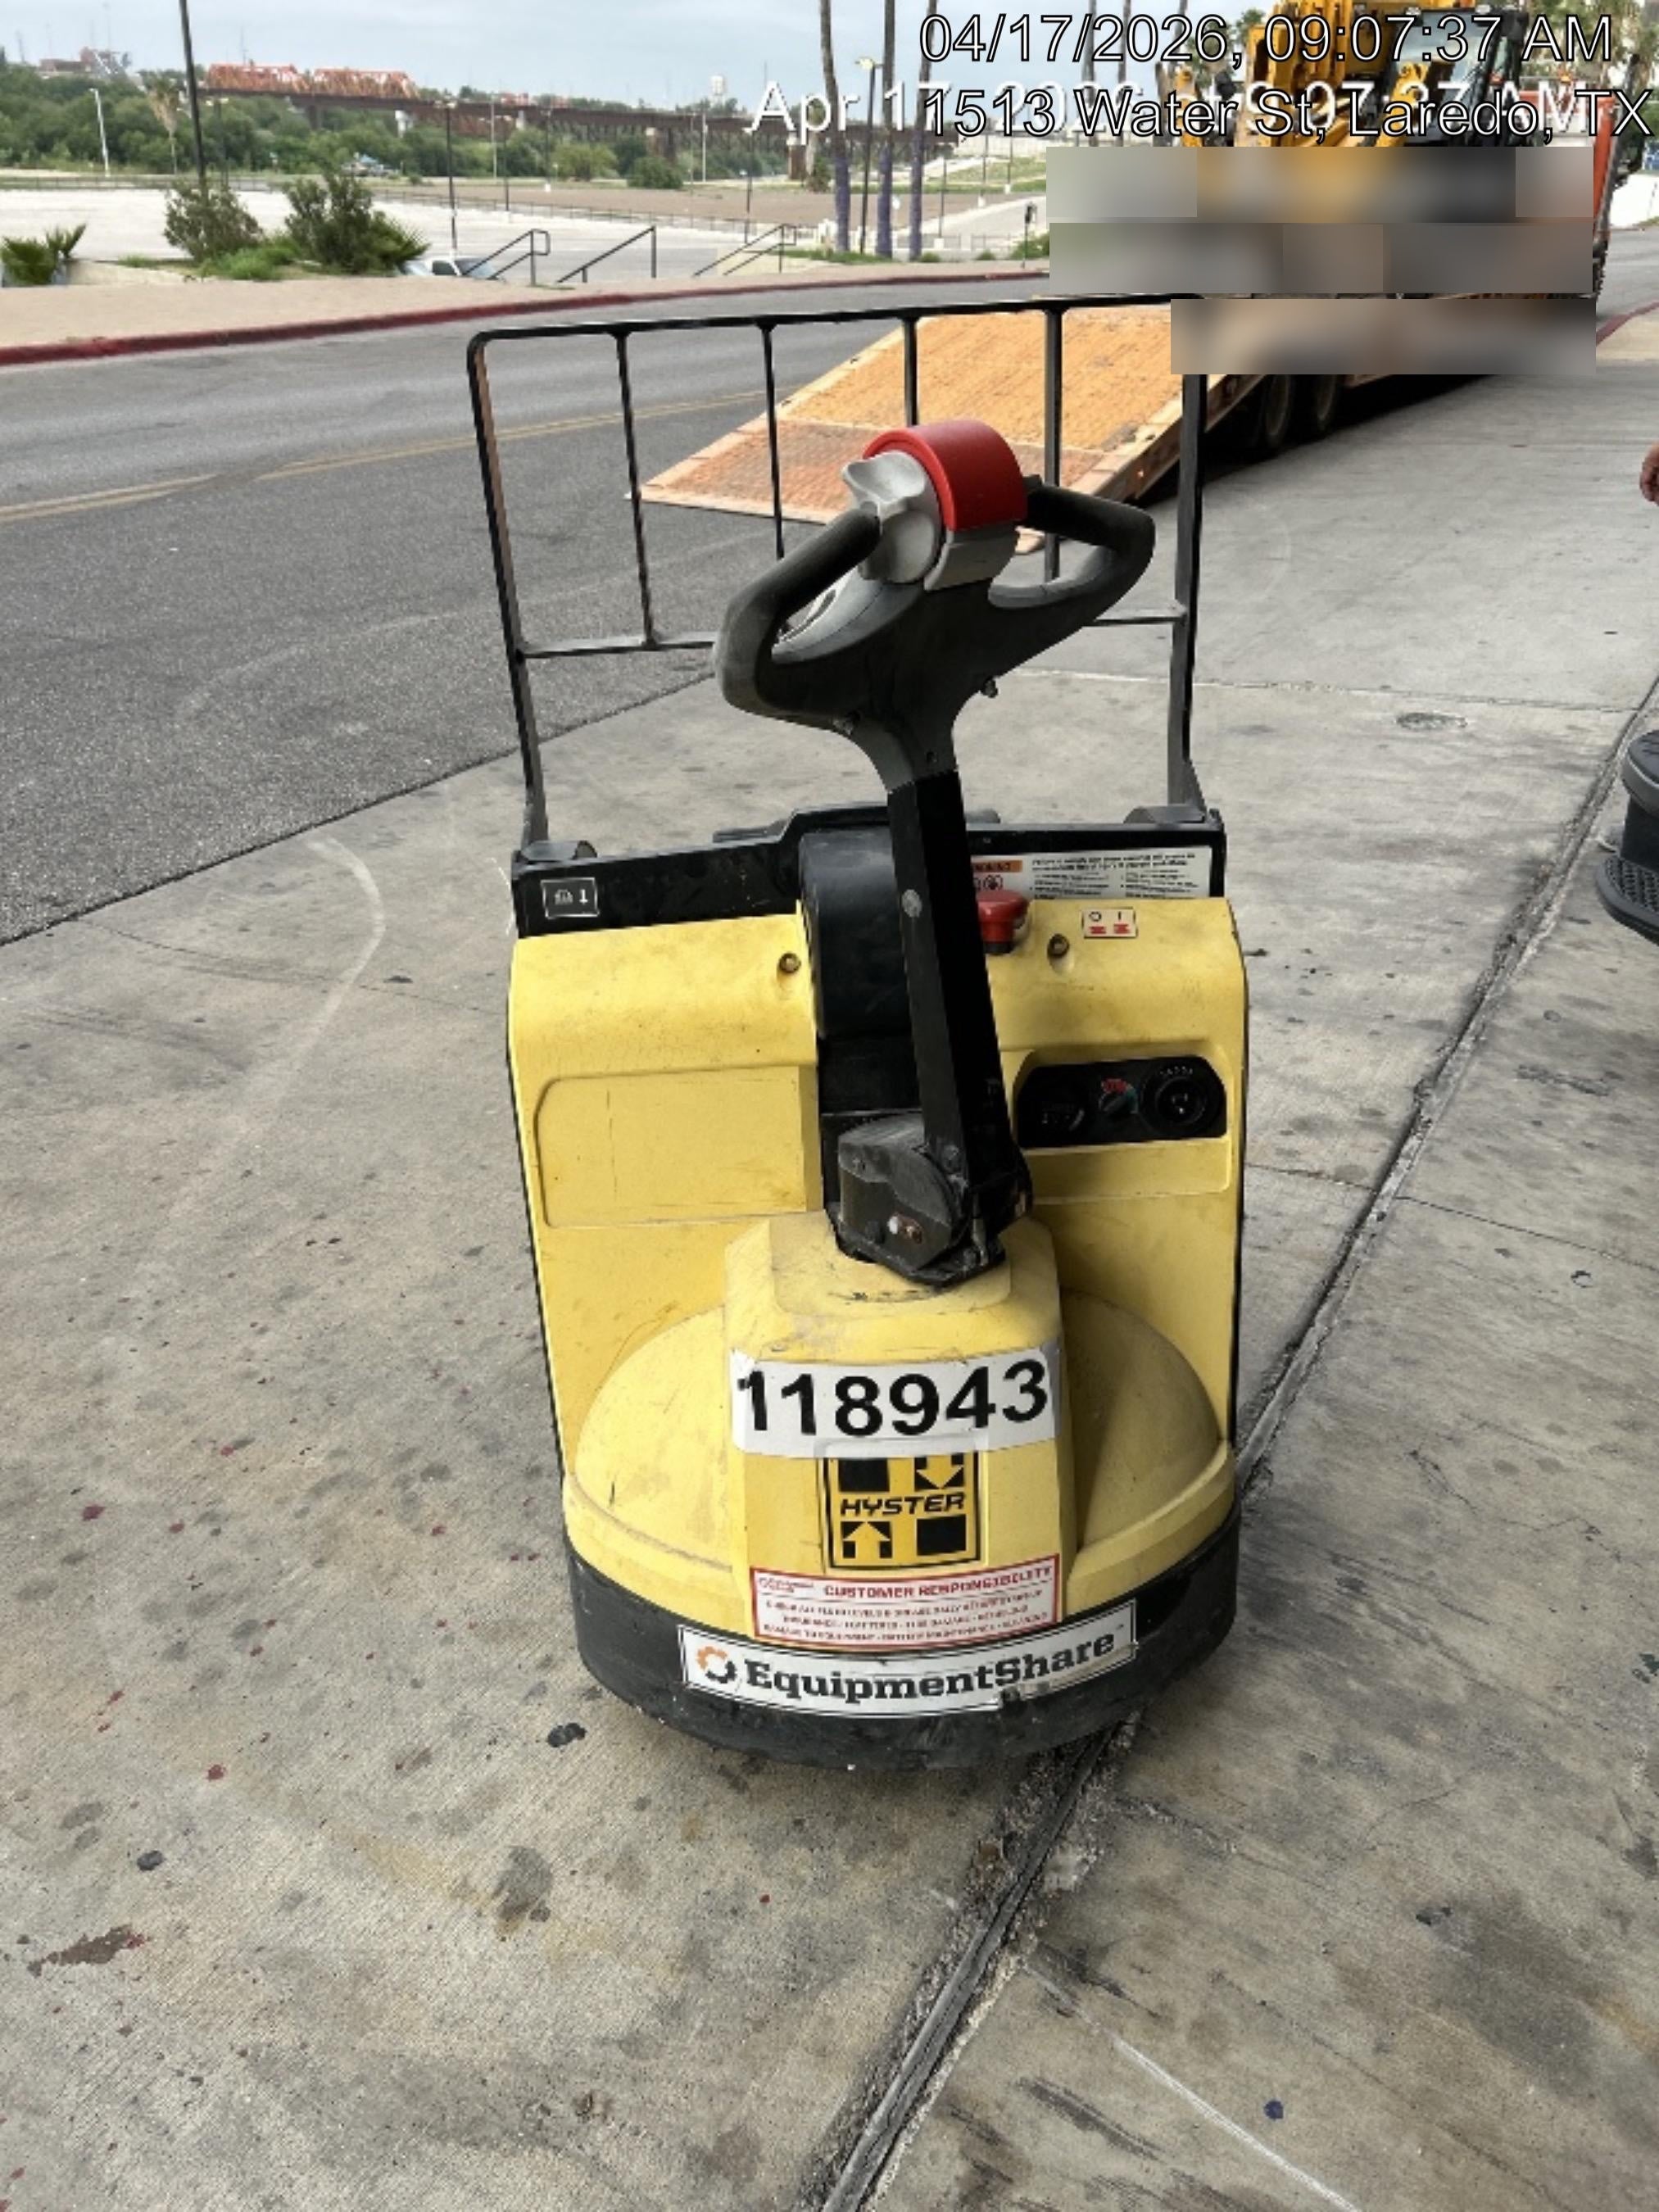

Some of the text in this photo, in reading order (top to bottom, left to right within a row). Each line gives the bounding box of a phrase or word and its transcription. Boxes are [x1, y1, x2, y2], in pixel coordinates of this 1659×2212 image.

[737, 1358, 1049, 1438] 118943
[840, 1493, 965, 1516] HYSTER
[745, 1632, 1116, 1705] EquipmentShare
